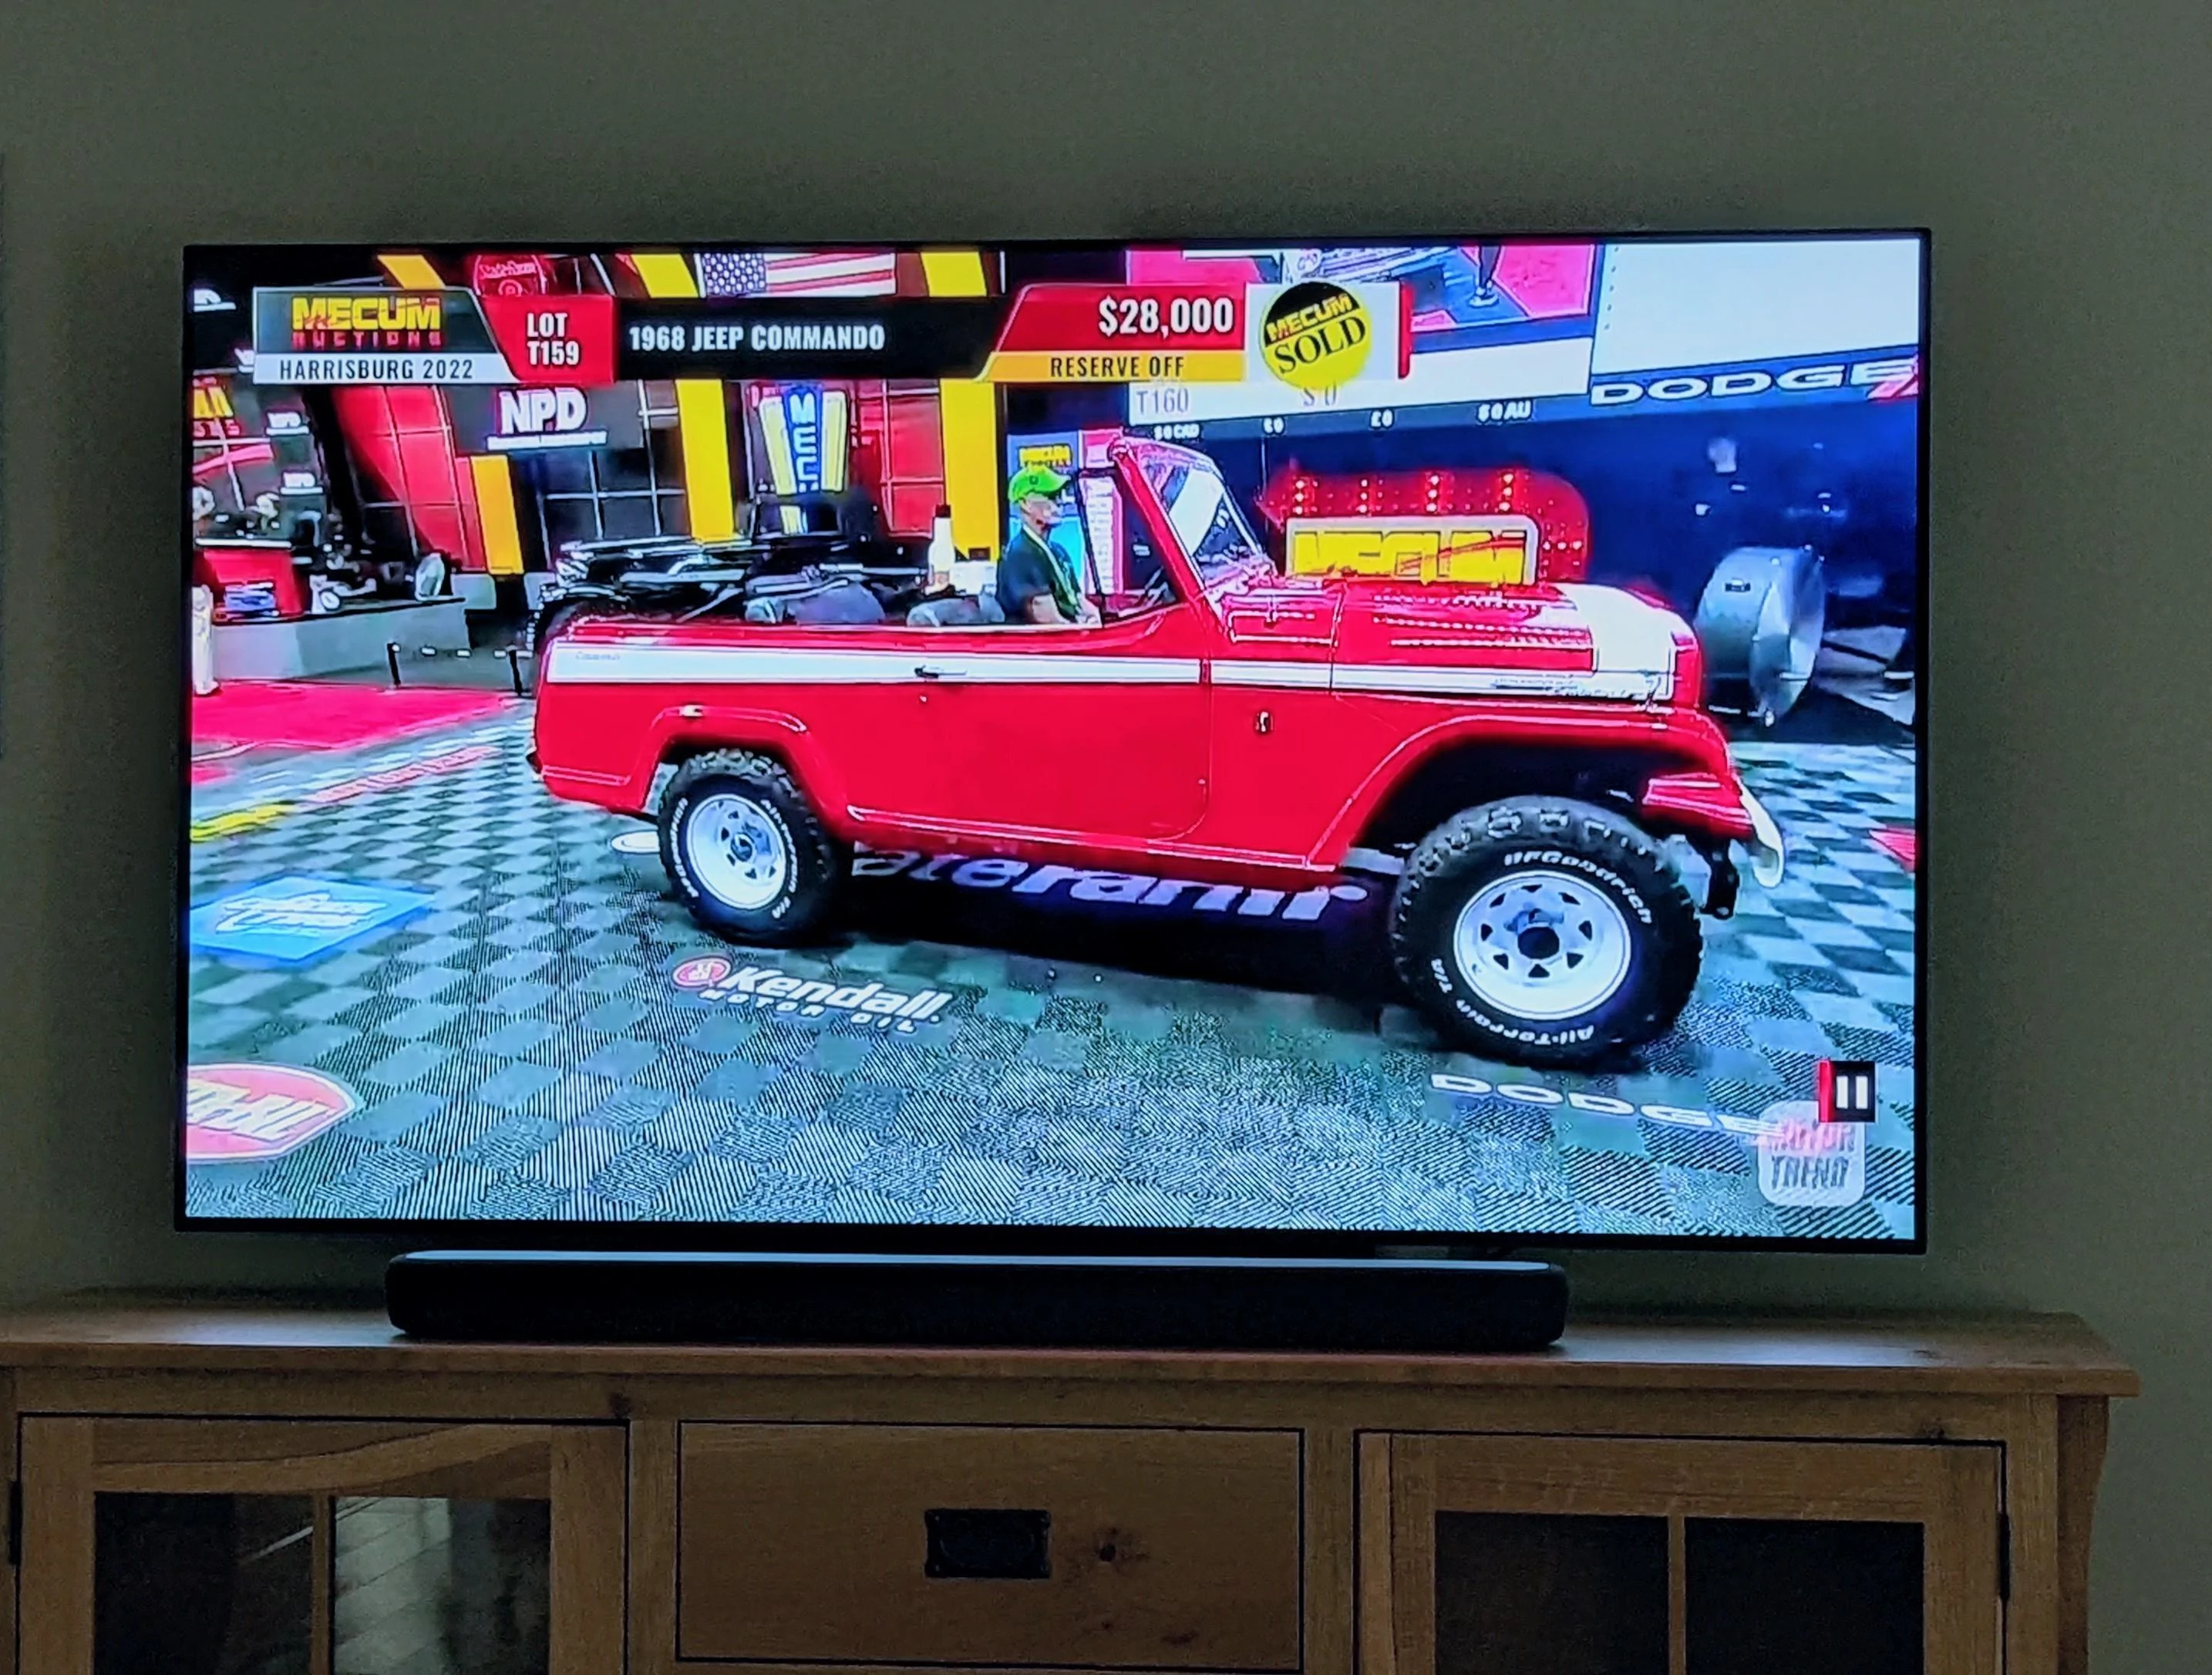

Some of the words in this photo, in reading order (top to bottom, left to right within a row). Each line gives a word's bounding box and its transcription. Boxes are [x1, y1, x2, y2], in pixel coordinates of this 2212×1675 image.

[292, 297, 440, 330] MECUM
[527, 312, 568, 338] LOT
[1098, 295, 1235, 339] $28,000
[1265, 292, 1353, 342] MECUM
[527, 340, 580, 366] T159
[629, 325, 685, 351] 1968
[692, 326, 744, 352] JEEP
[750, 325, 886, 351] COMMANDO
[1274, 316, 1366, 374] SOLD
[281, 359, 413, 380] HARRISBURG
[423, 359, 473, 379] 2022
[1051, 356, 1140, 377] RESERVE
[1149, 356, 1184, 377] OFF
[1591, 358, 1917, 406] DODGE
[499, 387, 587, 434] NPD
[1136, 388, 1190, 414] T160
[700, 988, 825, 1017] MOTOR
[850, 1012, 915, 1034] OIL
[724, 966, 953, 1020] Kendall
[1431, 1074, 1784, 1137] DODGE
